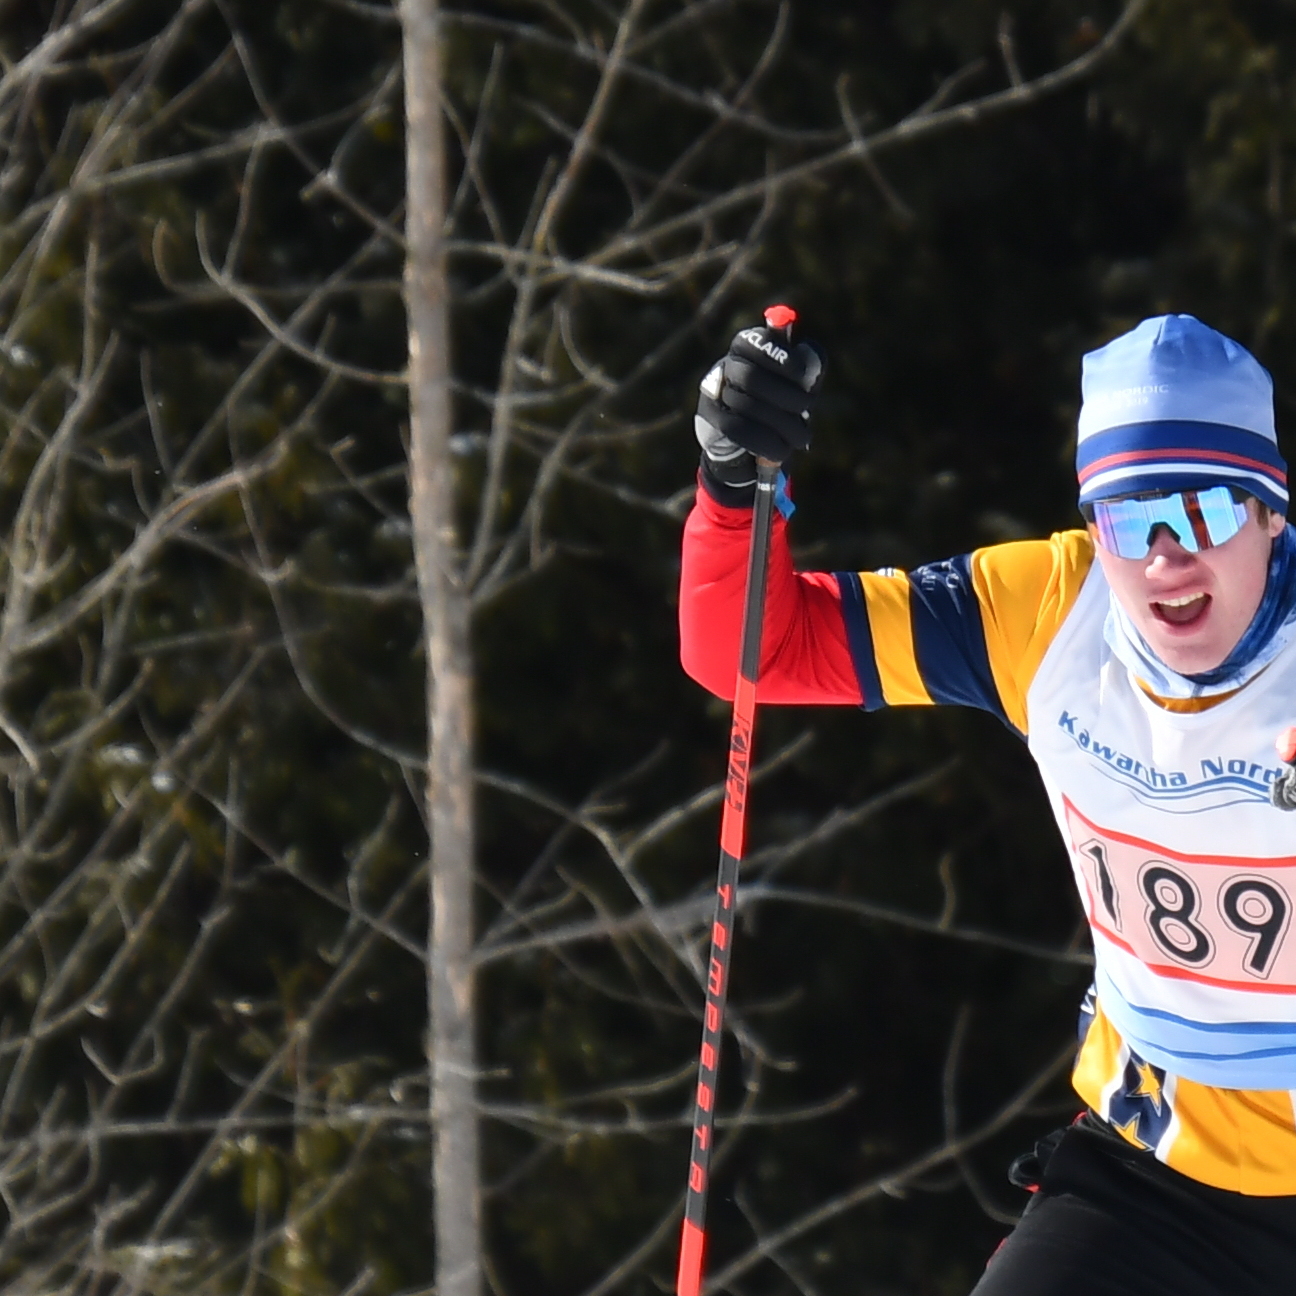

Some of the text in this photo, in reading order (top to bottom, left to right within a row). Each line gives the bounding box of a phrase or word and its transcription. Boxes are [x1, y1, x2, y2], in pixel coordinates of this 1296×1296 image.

[738, 329, 788, 365] UCLAIR
[1201, 756, 1284, 785] Nord
[1079, 838, 1293, 980] 189
[690, 883, 732, 1193] TEMPESTA
